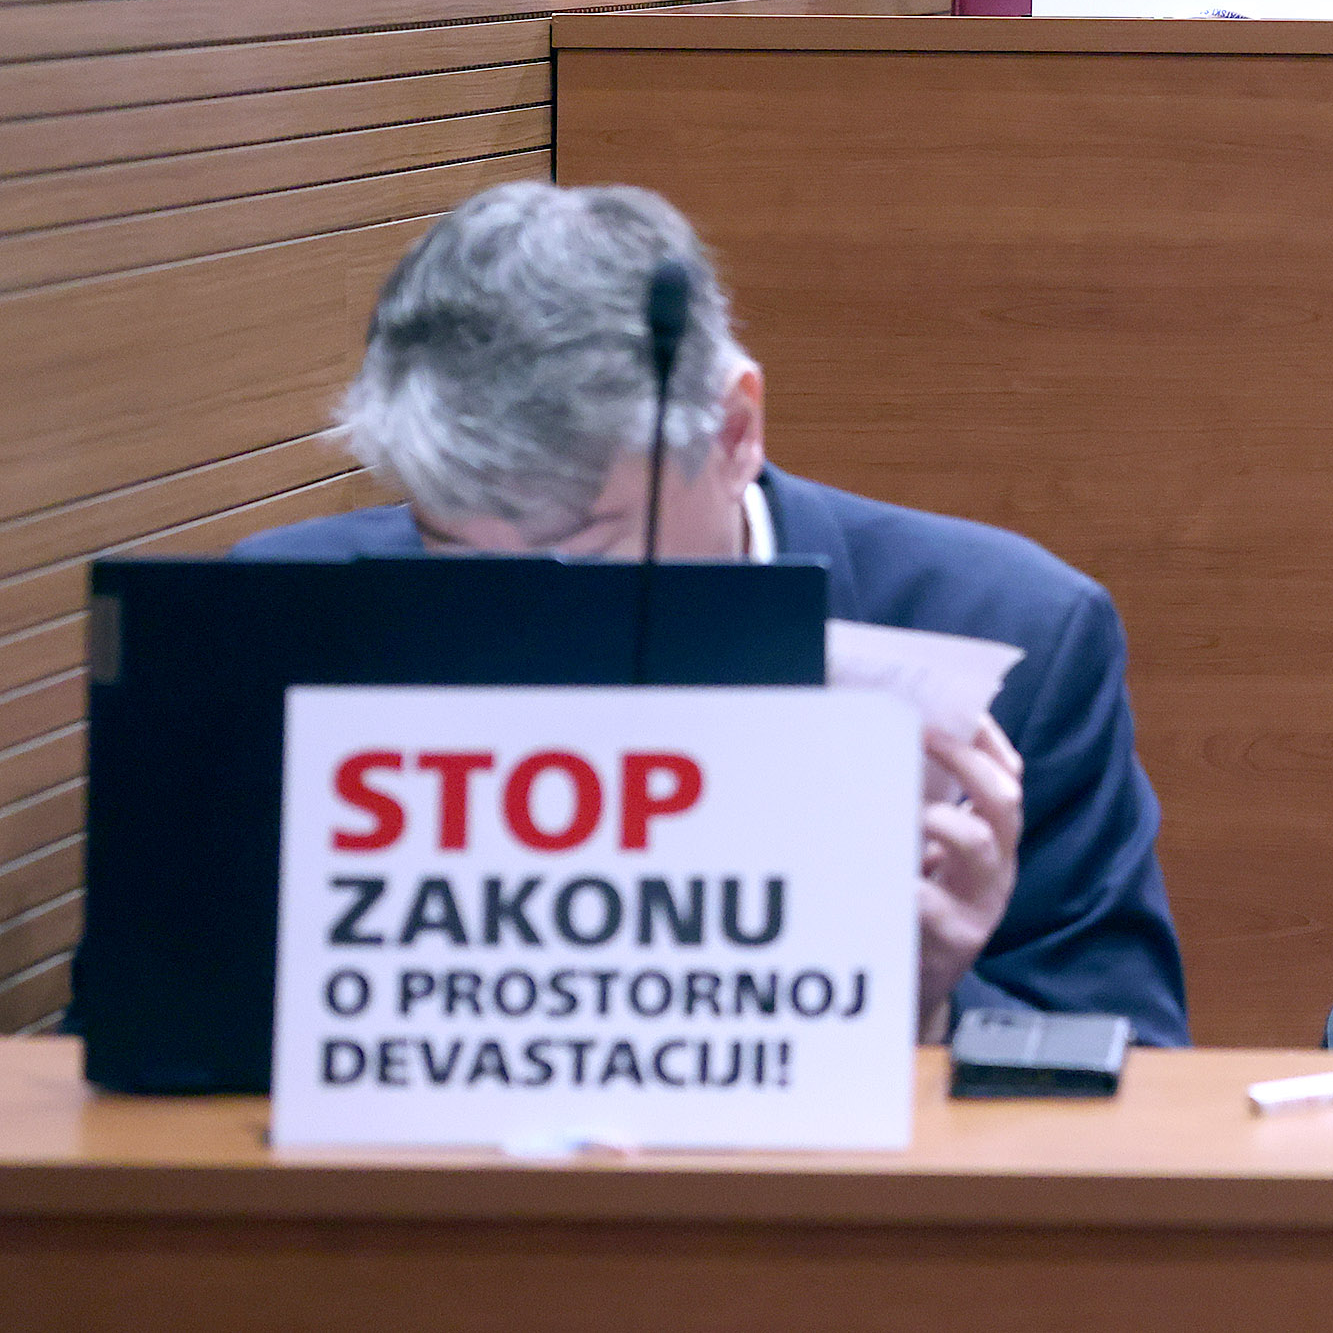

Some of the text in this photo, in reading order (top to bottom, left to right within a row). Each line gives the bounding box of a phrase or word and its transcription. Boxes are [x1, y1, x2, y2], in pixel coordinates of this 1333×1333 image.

[332, 750, 703, 853] STOP
[328, 876, 784, 947] ZAKONU
[324, 970, 865, 1017] O PROSTORNOJ
[322, 1039, 789, 1085] DEVASTACIJI!
